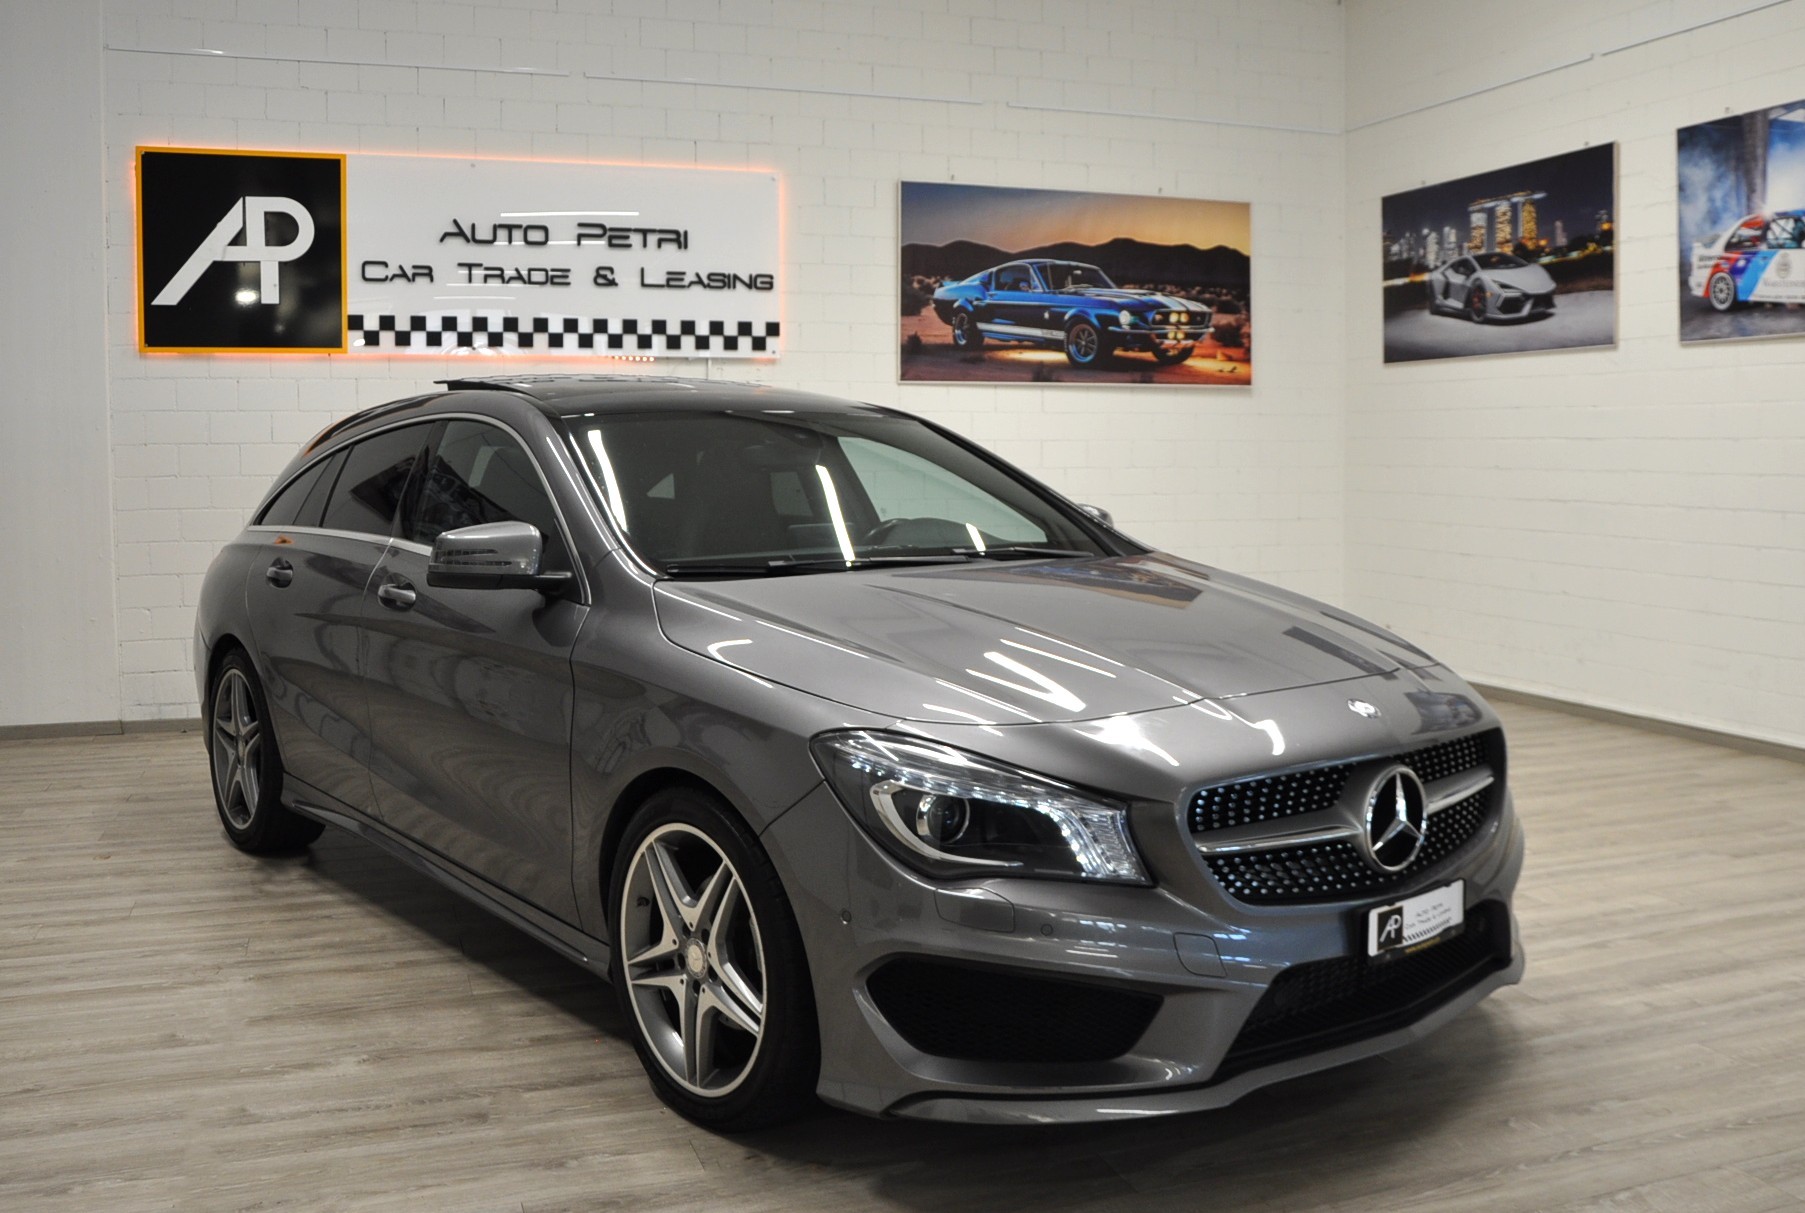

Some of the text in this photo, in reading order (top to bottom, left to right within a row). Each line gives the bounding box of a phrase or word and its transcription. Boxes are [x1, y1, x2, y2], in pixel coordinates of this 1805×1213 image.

[439, 218, 689, 250] AUTO PETRI
[151, 196, 315, 305] AP
[361, 260, 774, 291] CAR TRADE & LEASING
[1379, 914, 1402, 943] AP
